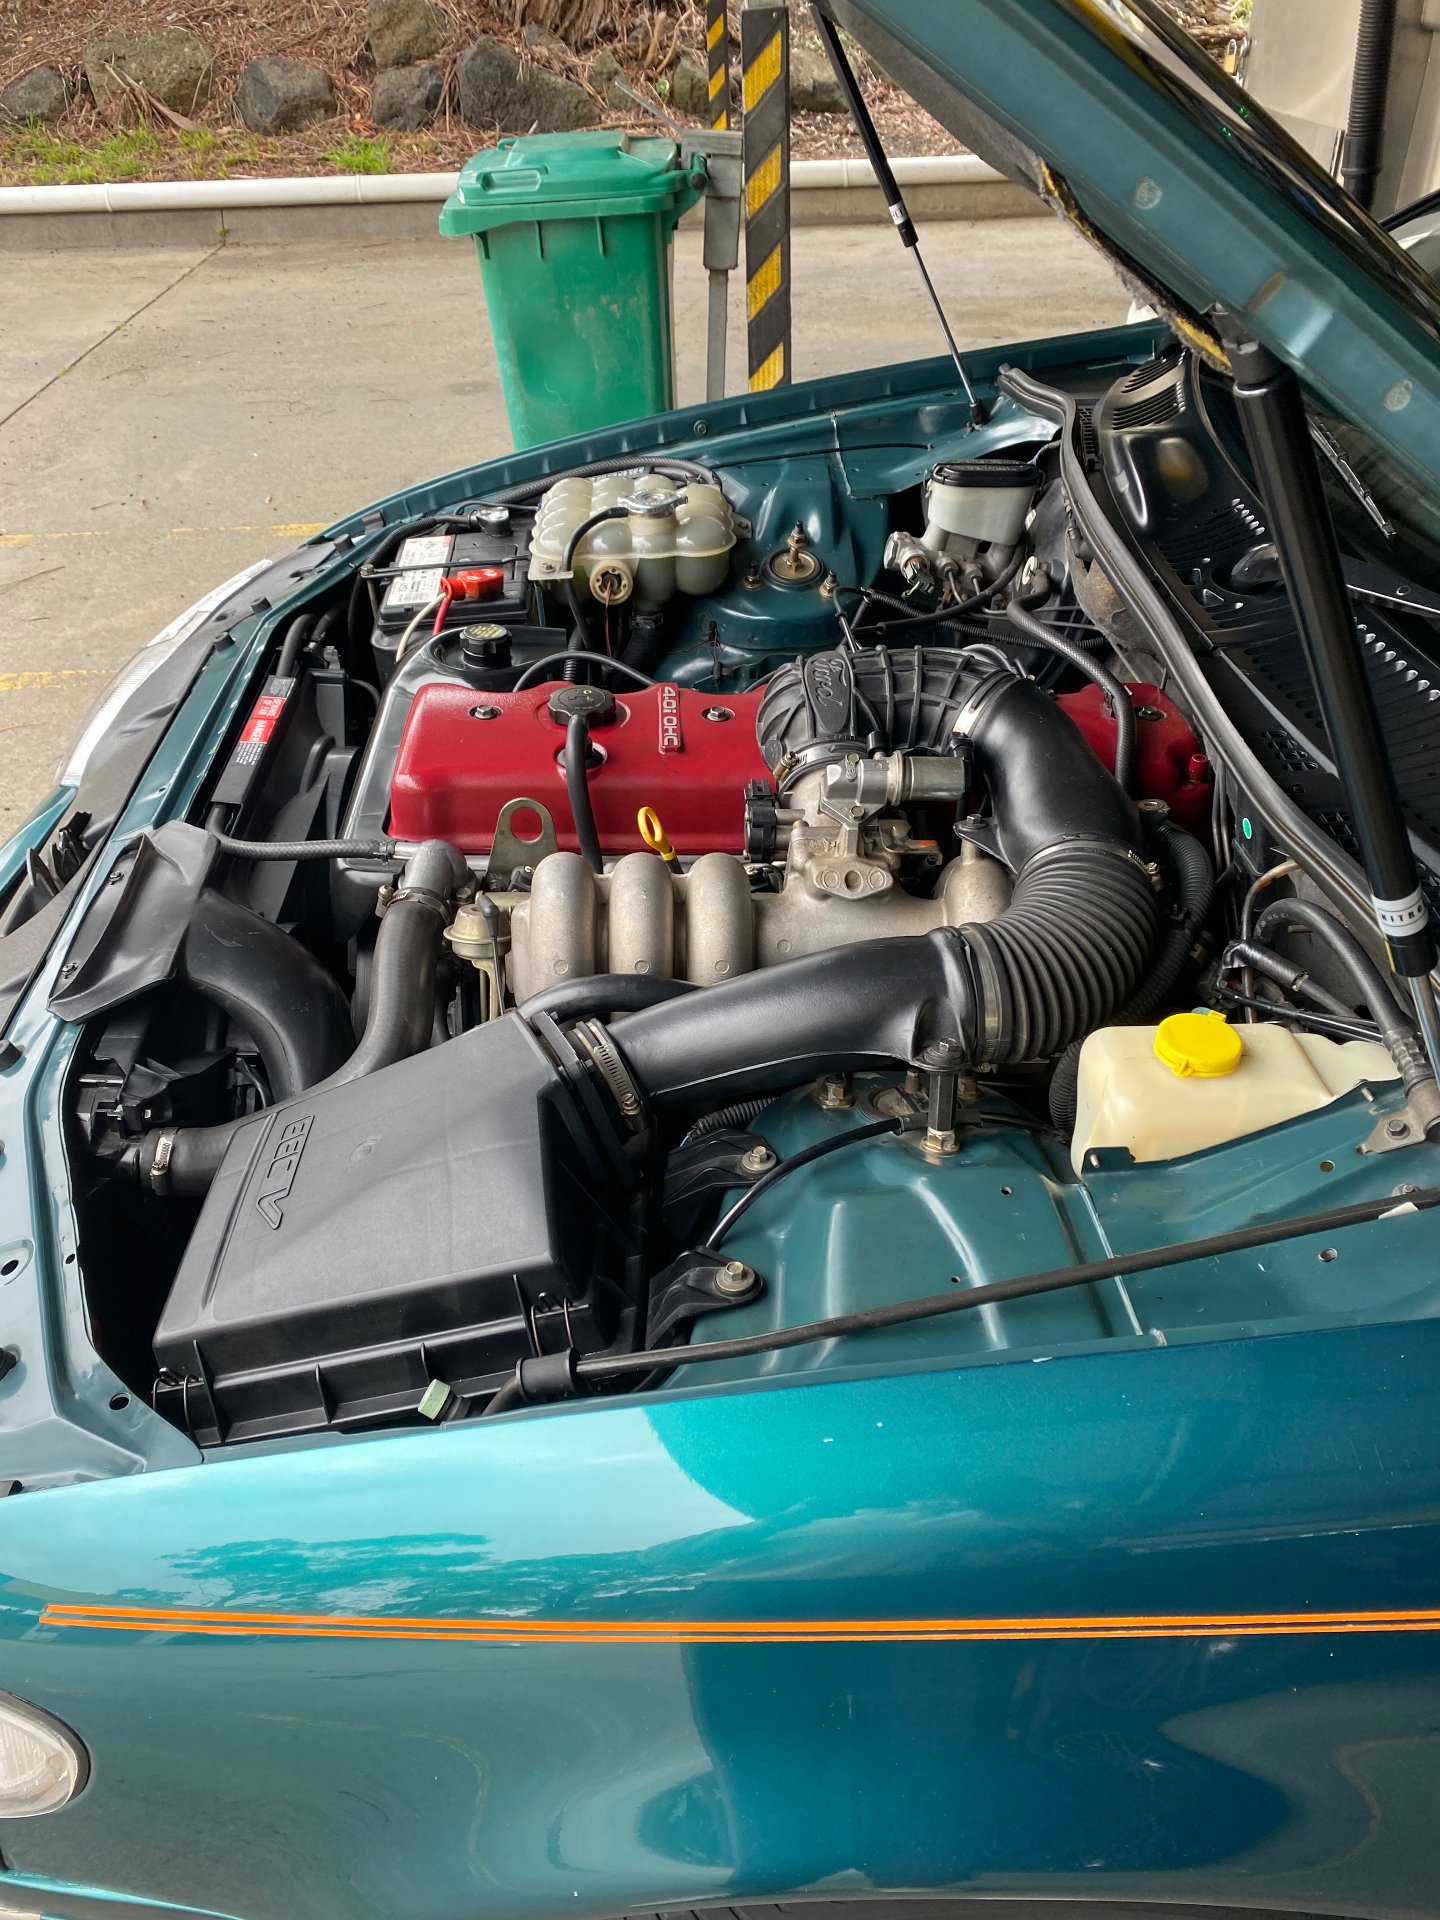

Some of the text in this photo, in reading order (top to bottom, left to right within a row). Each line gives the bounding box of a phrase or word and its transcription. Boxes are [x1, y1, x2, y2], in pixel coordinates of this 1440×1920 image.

[811, 658, 847, 706] Ford
[249, 719, 268, 741] DANGER
[663, 686, 679, 746] 4.0i OHC
[1381, 904, 1423, 922] NITRO
